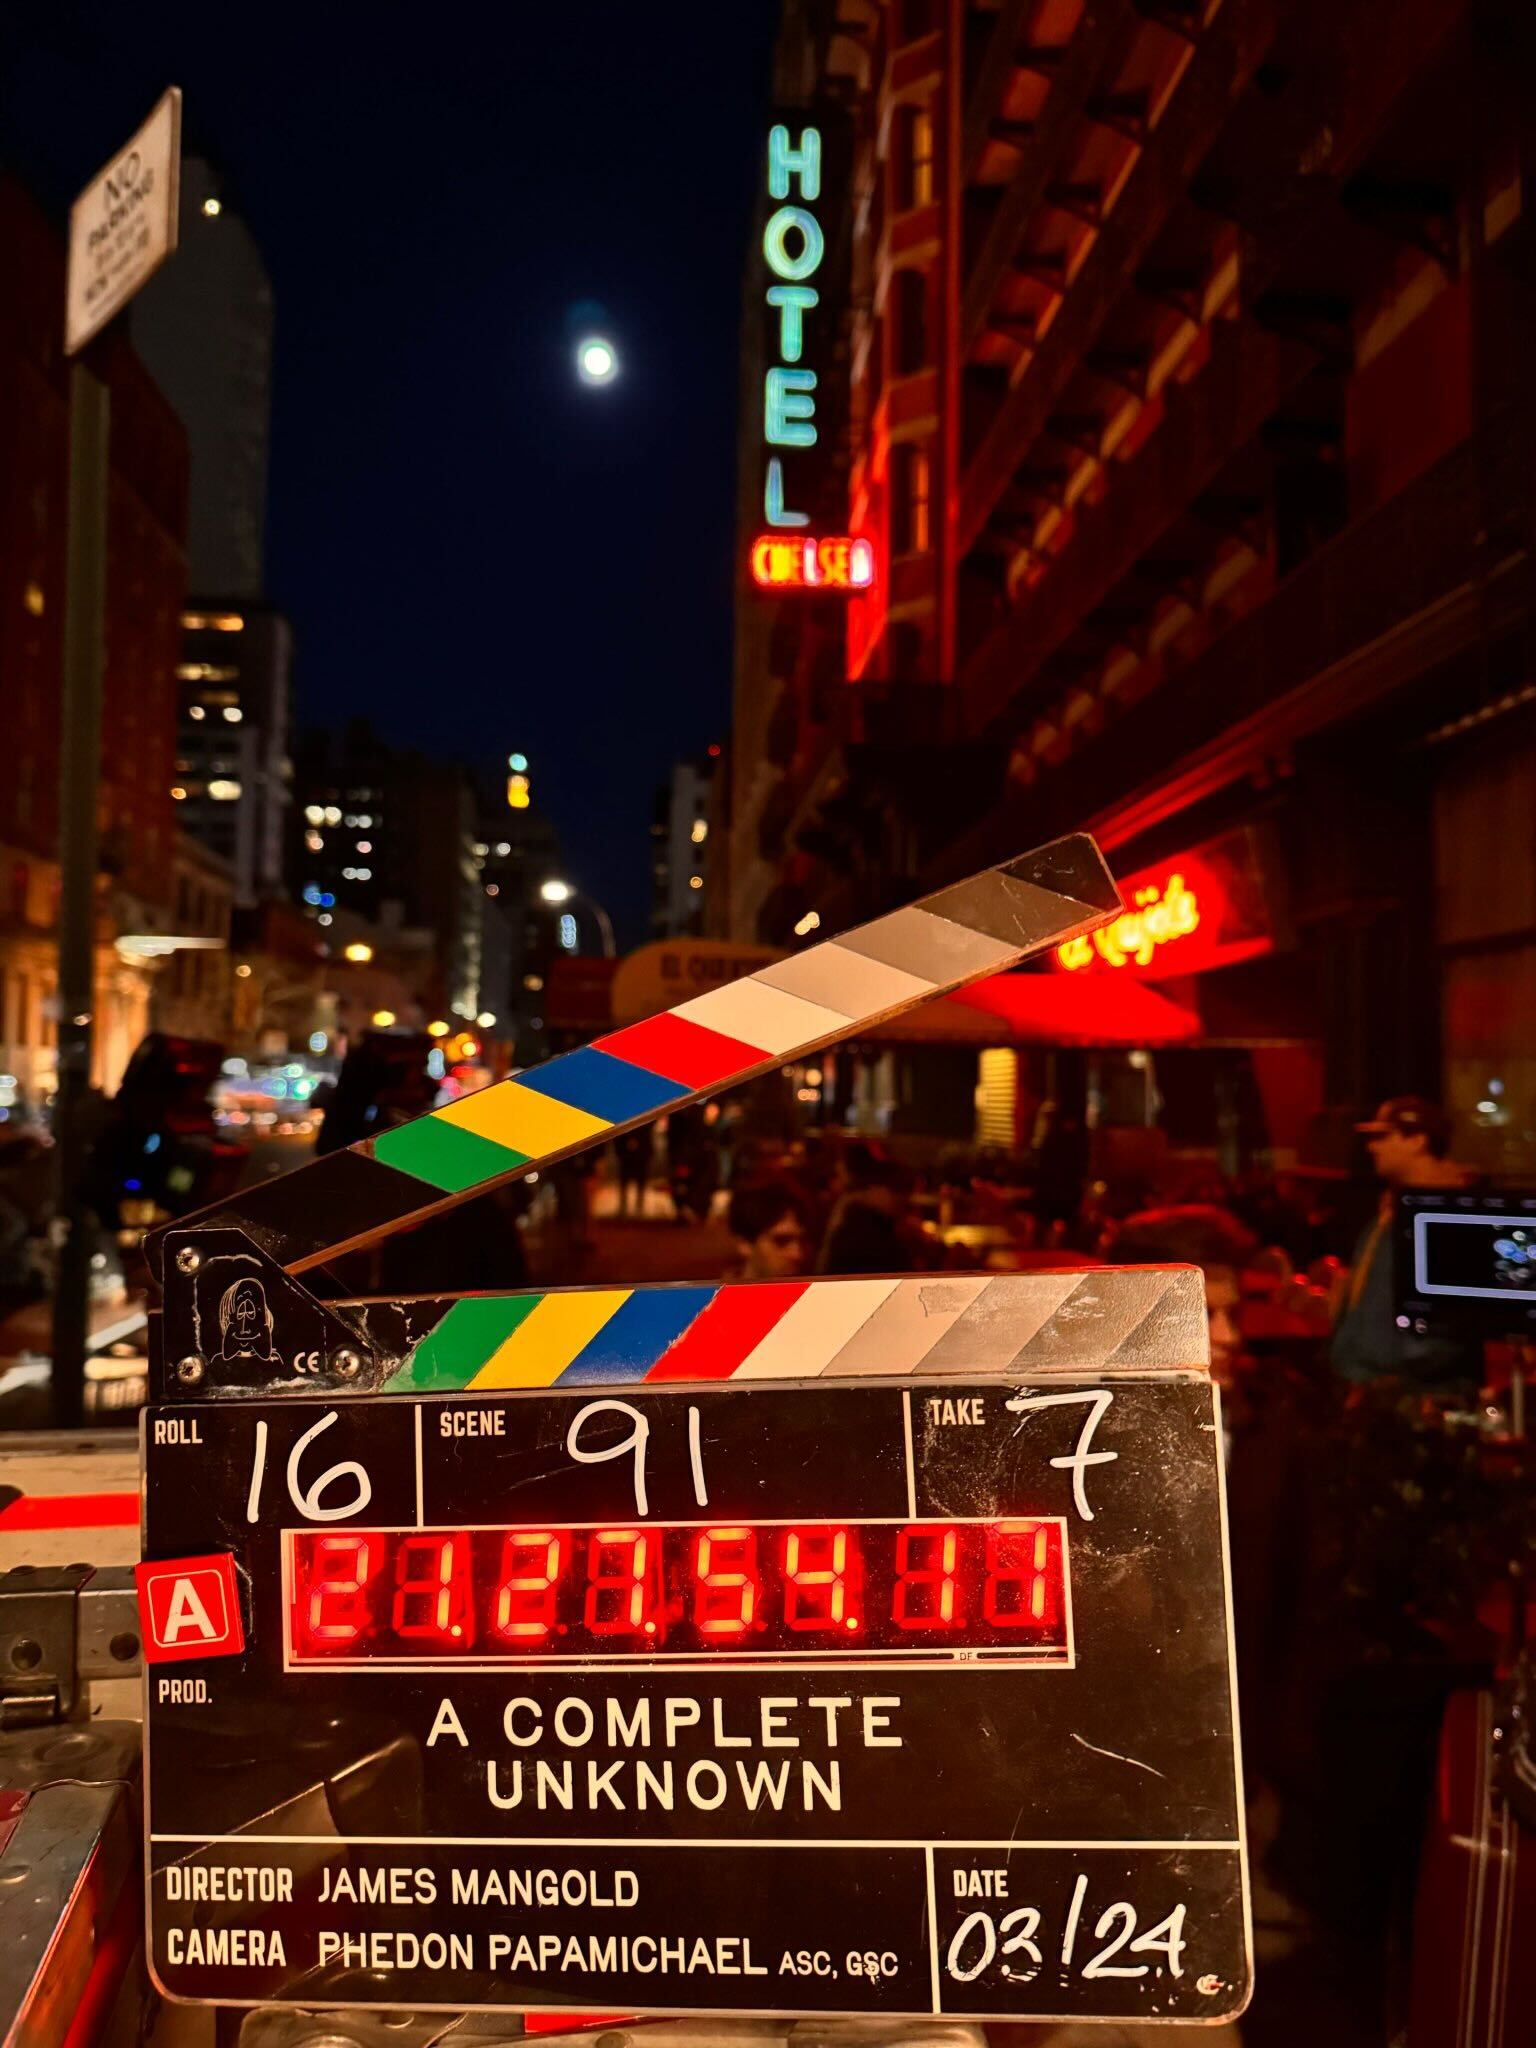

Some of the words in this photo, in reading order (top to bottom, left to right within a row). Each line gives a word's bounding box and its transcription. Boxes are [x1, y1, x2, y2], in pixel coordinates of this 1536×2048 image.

[763, 124, 824, 527] HOTEL
[154, 1419, 203, 1445] ROLL
[440, 1410, 506, 1438] SCENE
[929, 1398, 986, 1426] TAKE
[247, 1411, 372, 1523] 16
[567, 1400, 708, 1516] 91
[1005, 1389, 1118, 1521] 7
[163, 1578, 217, 1643] A
[158, 1679, 213, 1704] PROD.
[426, 1698, 469, 1747] A
[503, 1696, 904, 1748] COMPLETE
[487, 1759, 842, 1811] UNKNOWN
[166, 1866, 293, 1903] DIRECTOR
[318, 1867, 438, 1905] JAMES
[451, 1869, 639, 1907] MANGOLD
[953, 1869, 1009, 1897] DATE
[167, 1928, 287, 1967] CAMERA
[318, 1931, 474, 1971] PHEDON
[488, 1935, 768, 1975] PAPAMICHAEL
[778, 1950, 839, 1979] ASC,
[845, 1950, 899, 1977] GSC
